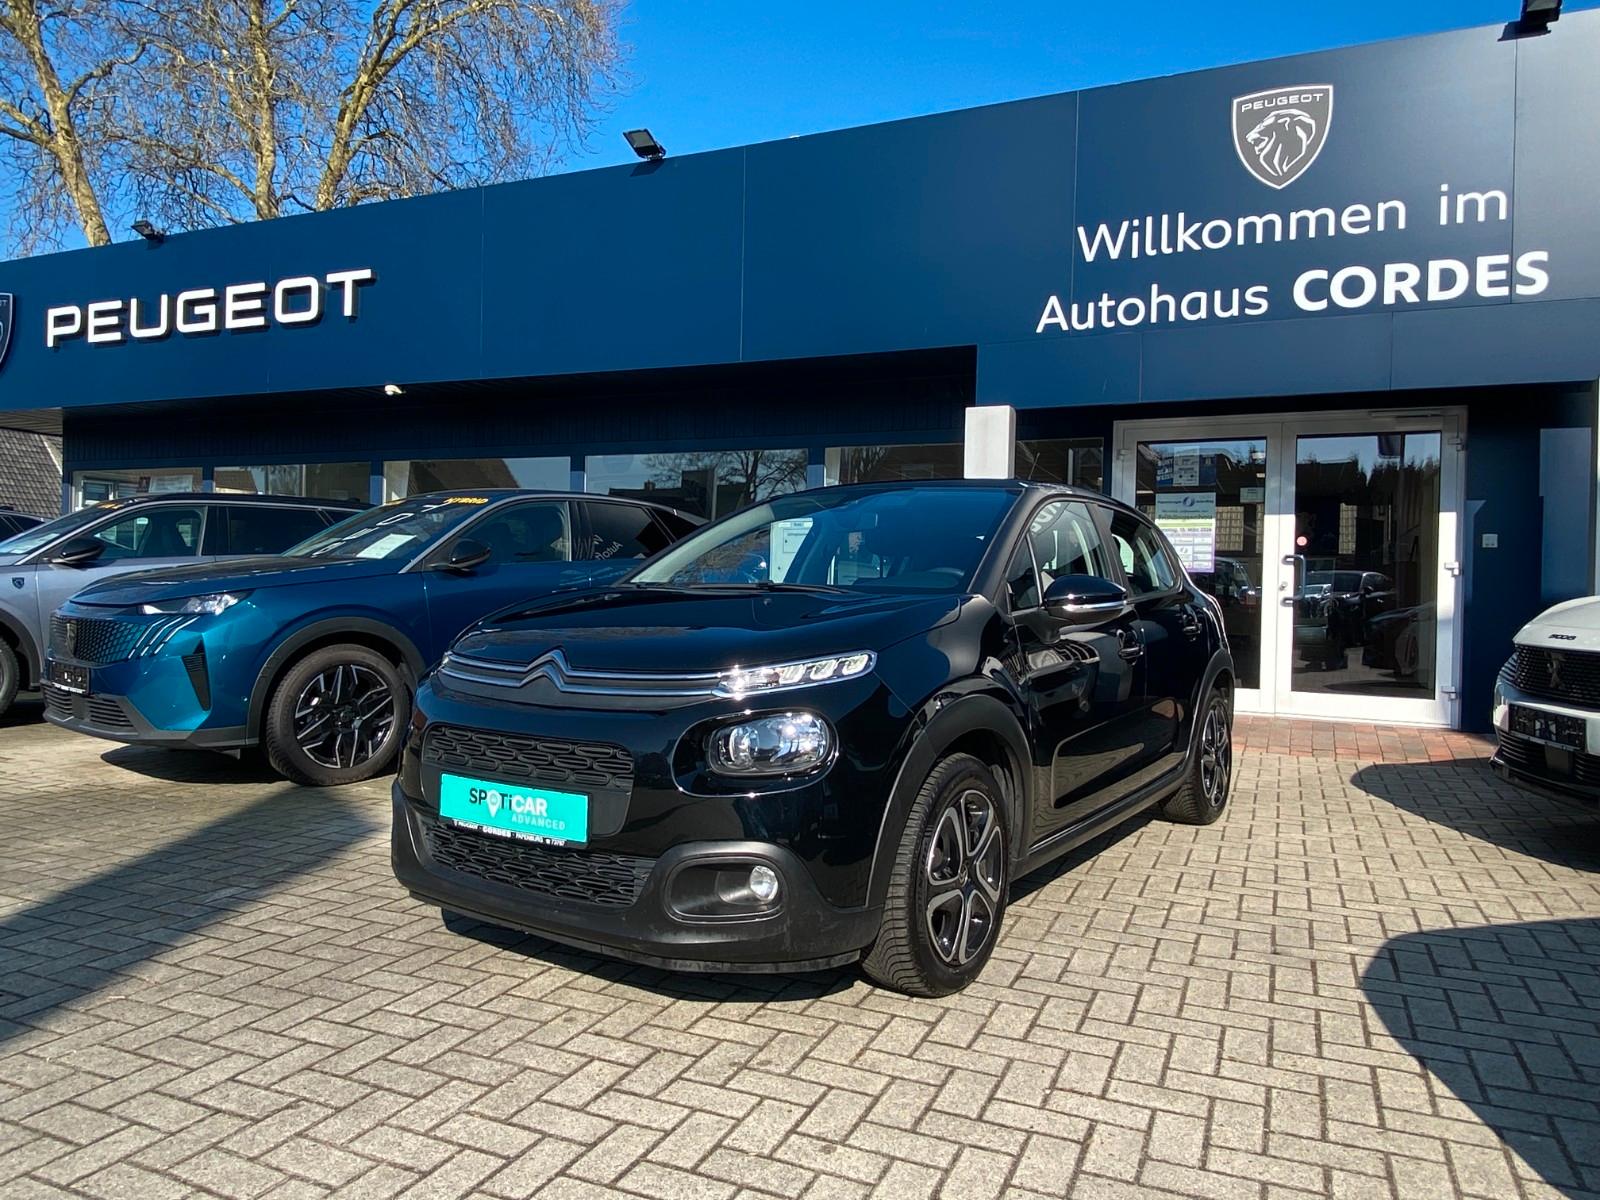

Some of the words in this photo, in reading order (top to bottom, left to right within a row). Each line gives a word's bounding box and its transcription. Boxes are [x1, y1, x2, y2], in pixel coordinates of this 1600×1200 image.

[1241, 93, 1324, 113] PEUGEOT
[1077, 200, 1407, 262] Willkommen
[1439, 183, 1508, 226] im
[47, 268, 373, 348] PEUGEOT
[1036, 283, 1269, 333] Autohaus
[1292, 250, 1550, 312] CORDES
[482, 825, 512, 838] CORDES
[511, 813, 566, 831] ADVANCED
